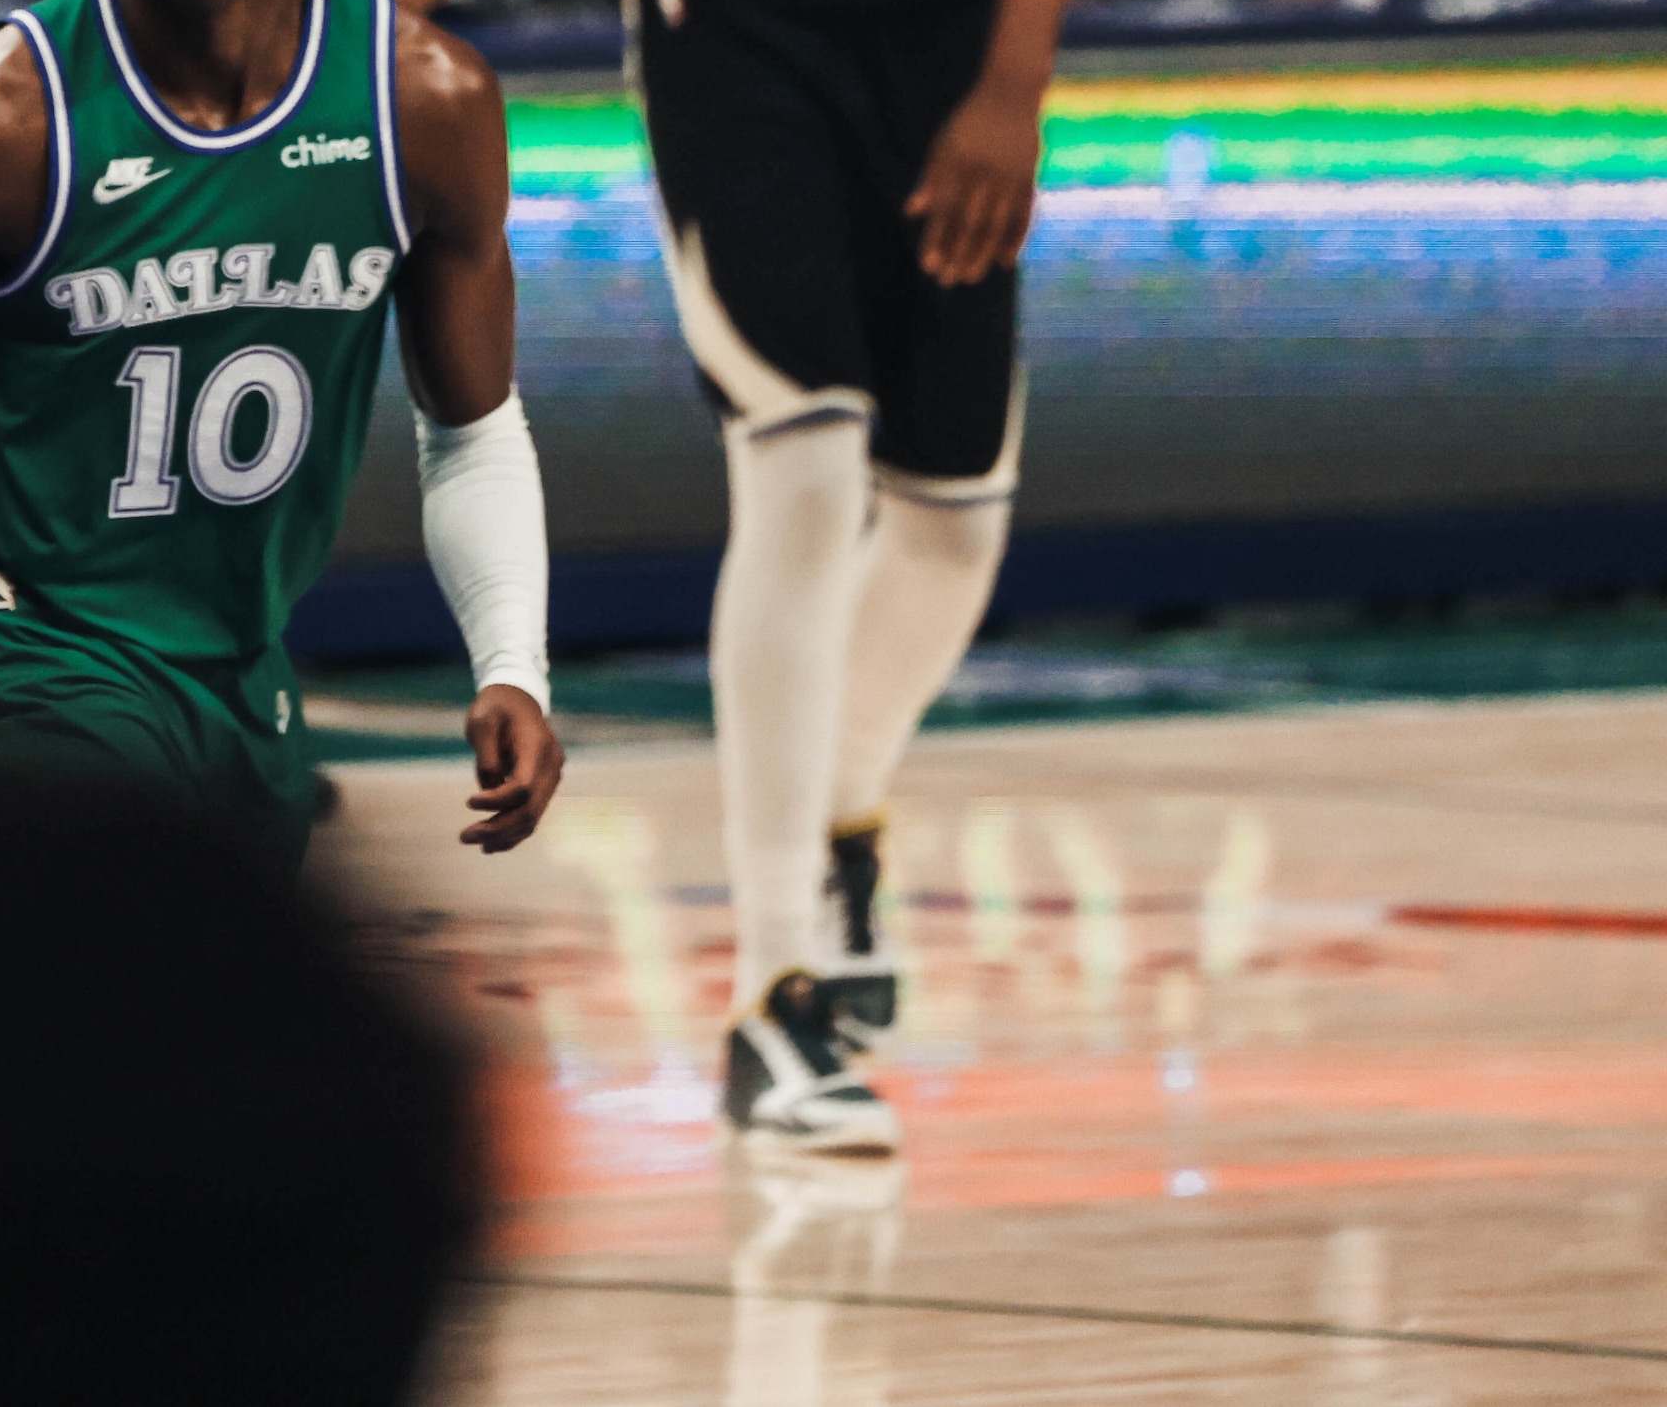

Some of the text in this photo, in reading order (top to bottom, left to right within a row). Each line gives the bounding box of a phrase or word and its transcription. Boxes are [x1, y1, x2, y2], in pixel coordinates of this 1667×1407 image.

[280, 132, 372, 169] chime
[44, 242, 396, 336] DALLAS
[108, 344, 315, 519] 10
